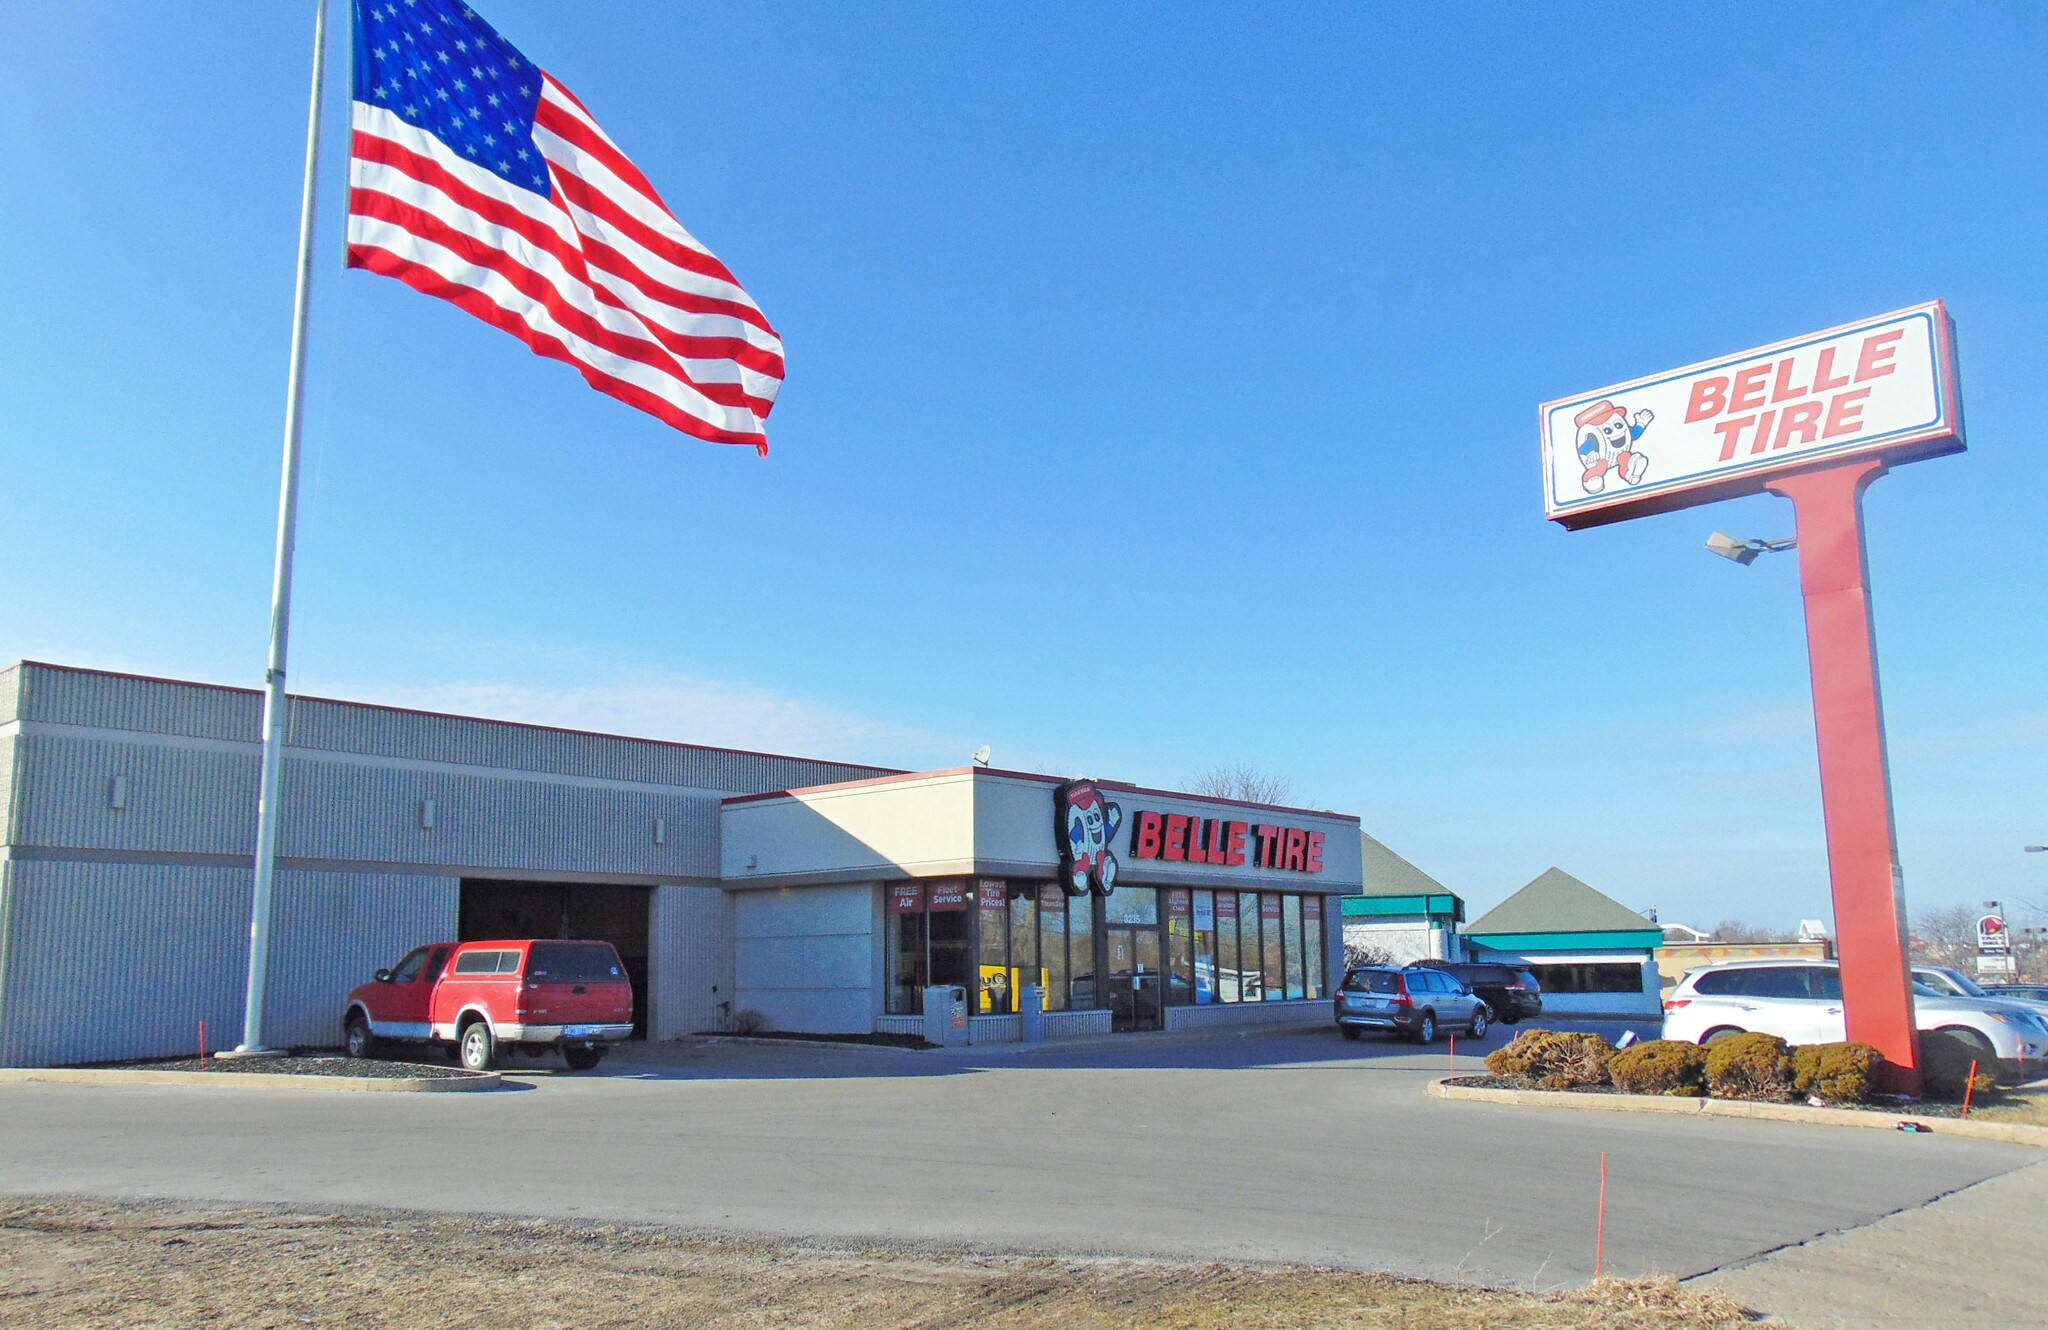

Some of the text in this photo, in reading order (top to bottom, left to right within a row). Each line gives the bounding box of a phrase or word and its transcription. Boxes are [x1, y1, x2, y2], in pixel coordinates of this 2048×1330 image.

[1684, 328, 1904, 424] BELLE
[1714, 386, 1872, 462] TIRE
[1134, 810, 1326, 873] BELLE TIRE
[937, 885, 958, 894] Fleet
[979, 880, 1006, 889] Lowest
[895, 886, 918, 896] FREE
[986, 888, 1001, 897] Tire
[899, 897, 913, 907] Air
[933, 894, 963, 904] Service
[980, 898, 1006, 907] Prices!
[1123, 914, 1141, 924] 3235
